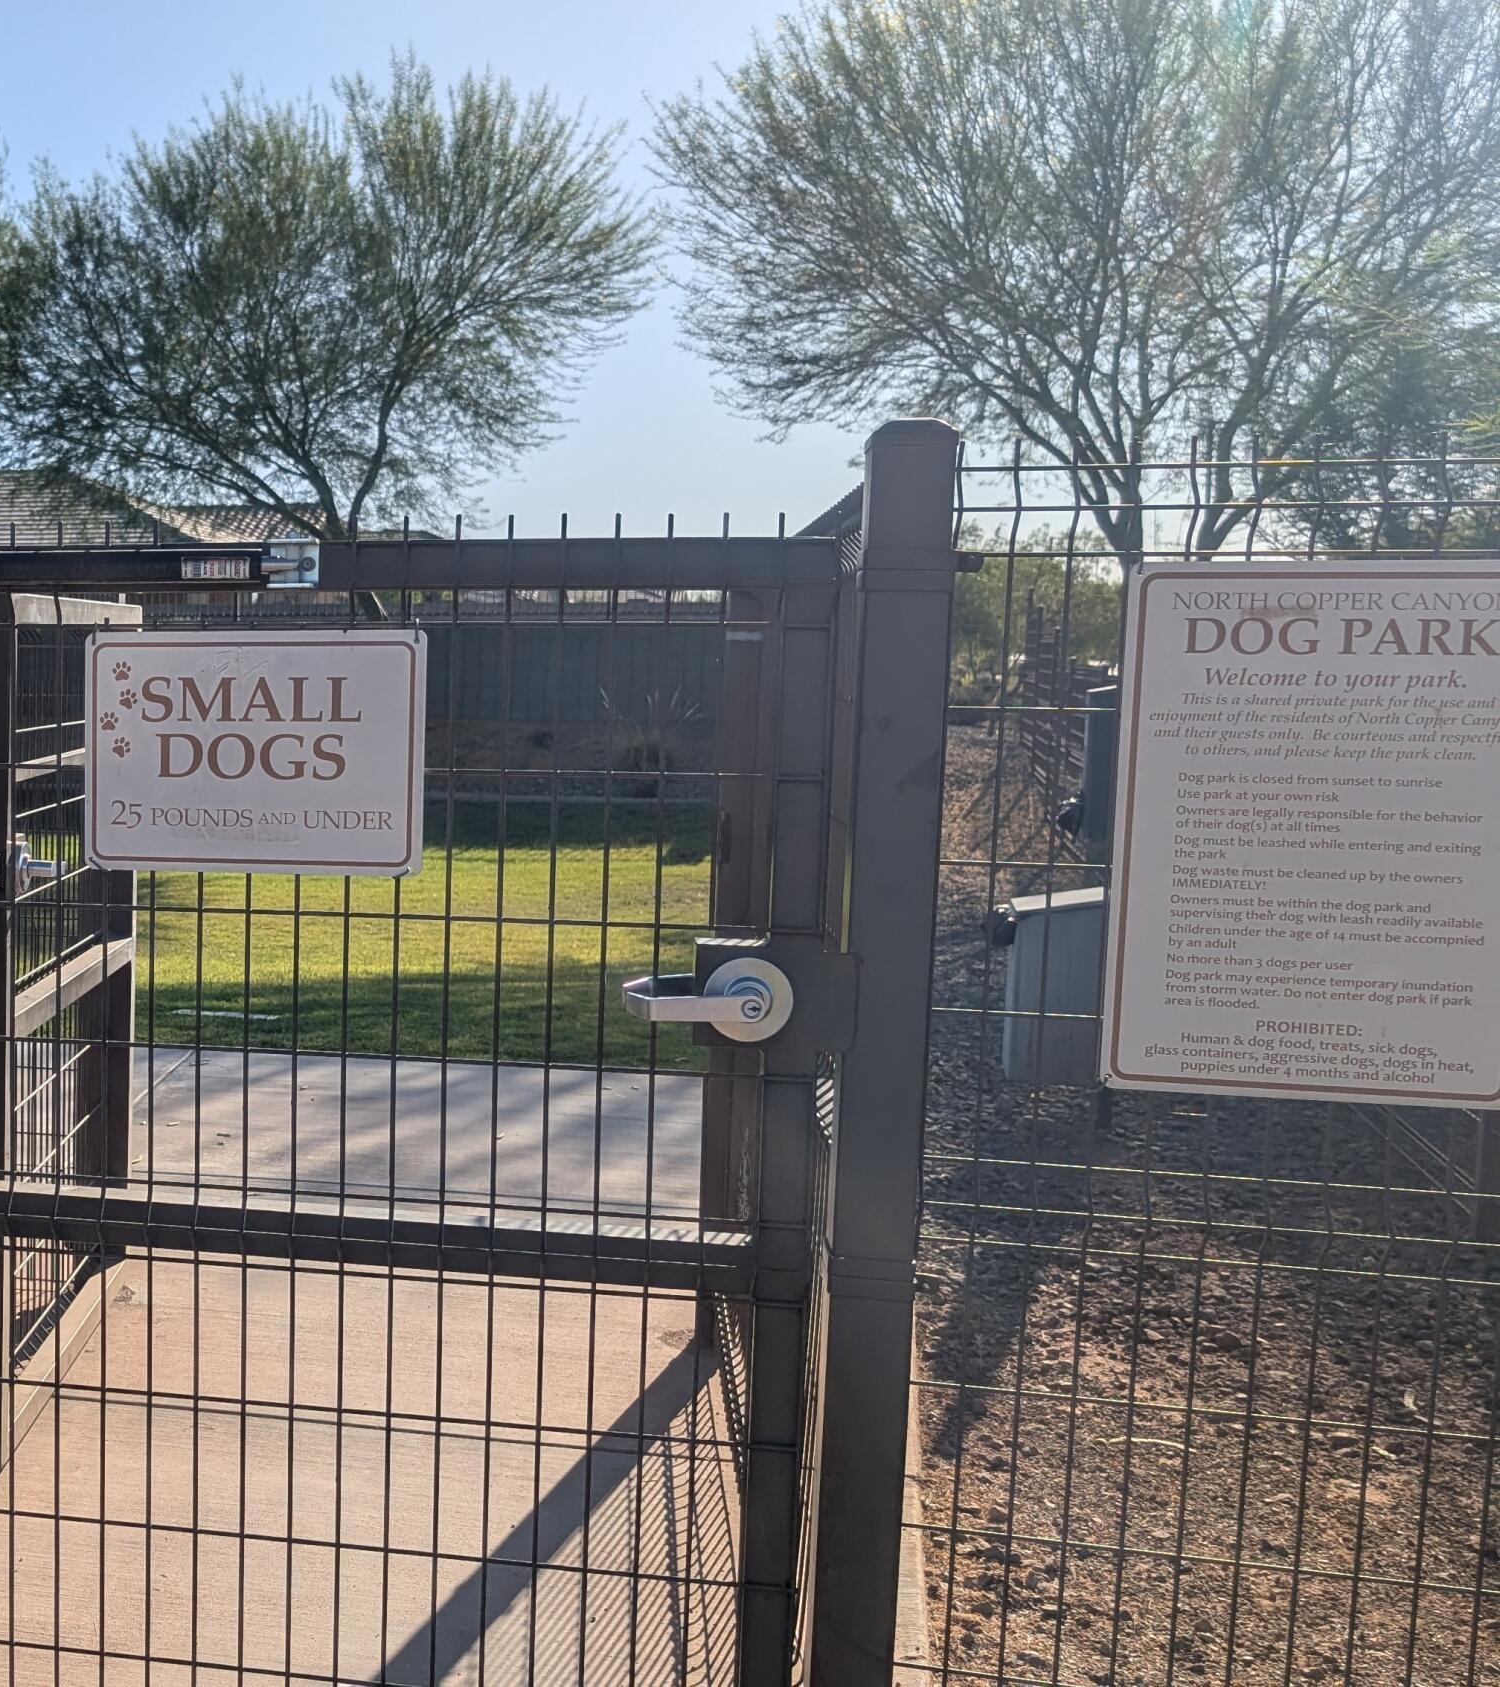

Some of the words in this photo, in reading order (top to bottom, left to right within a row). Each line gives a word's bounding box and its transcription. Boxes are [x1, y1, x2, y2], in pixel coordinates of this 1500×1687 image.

[1172, 591, 1268, 610] NORTH
[1276, 592, 1382, 611] COPPER
[1183, 617, 1320, 656] DOG
[1337, 618, 1500, 656] PARK
[1204, 667, 1307, 687] Welcome
[1313, 669, 1337, 687] to
[1344, 672, 1399, 693] your
[1404, 670, 1467, 693] park.
[141, 676, 362, 723] SMALL
[1181, 693, 1212, 705] This
[1216, 694, 1227, 705] is
[1231, 696, 1240, 705] a
[1244, 694, 1291, 706] shared
[1294, 695, 1346, 709] private
[1349, 696, 1384, 710] park
[1385, 696, 1409, 711] for
[1413, 696, 1436, 708] the
[1439, 699, 1463, 709] use
[1467, 697, 1496, 709] and
[1149, 710, 1224, 724] enjoyment
[1226, 710, 1243, 725] of
[1245, 711, 1268, 723] the
[1270, 711, 1334, 724] residents
[1338, 712, 1356, 727] of
[1356, 712, 1400, 725] North
[1404, 713, 1457, 728] Copper
[1153, 727, 1181, 738] and
[1184, 727, 1217, 738] their
[1219, 729, 1265, 742] guests
[1268, 728, 1304, 742] only.
[1313, 729, 1330, 741] Be
[1334, 731, 1404, 742] courteous
[1408, 731, 1436, 742] and
[155, 733, 346, 781] DOGS
[1184, 744, 1199, 755] to
[1203, 744, 1251, 757] others,
[1254, 745, 1282, 757] and
[1284, 746, 1330, 760] please
[1333, 746, 1366, 761] keep
[1370, 747, 1394, 759] the
[1395, 748, 1429, 762] park
[1433, 748, 1477, 760] clean.
[1178, 772, 1204, 785] Dog
[1207, 773, 1236, 785] park
[1239, 773, 1249, 784] is
[1252, 774, 1293, 785] closed
[1297, 774, 1328, 785] from
[1331, 776, 1374, 787] sunset
[1378, 777, 1392, 787] to
[1395, 777, 1443, 788] sunrise
[110, 800, 142, 829] 25
[150, 807, 253, 828] POUNDS
[258, 812, 296, 825] AND
[303, 810, 394, 831] UNDER
[1176, 805, 1225, 817] Owners
[1228, 808, 1249, 817] are
[1252, 807, 1294, 820] legally
[1297, 809, 1373, 821] responsible
[1376, 810, 1396, 820] for
[1399, 811, 1421, 822] the
[1424, 811, 1483, 823] behavior
[1176, 818, 1189, 829] of
[1193, 818, 1223, 830] their
[1226, 819, 1267, 833] dog(s)
[1270, 822, 1283, 831] at
[1286, 821, 1301, 832] all
[1304, 821, 1341, 833] times
[1174, 835, 1199, 848] Dog
[1203, 837, 1235, 847] must
[1238, 836, 1253, 847] be
[1257, 837, 1306, 849] leashed
[1310, 839, 1345, 850] while
[1348, 840, 1404, 854] entering
[1407, 842, 1432, 853] and
[1435, 842, 1481, 856] exiting
[1172, 865, 1197, 877] Dog
[1201, 867, 1239, 877] waste
[1242, 868, 1274, 878] must
[1277, 868, 1293, 879] be
[1296, 868, 1346, 880] cleaned
[1350, 872, 1366, 883] up
[1369, 871, 1385, 884] by
[1389, 871, 1410, 882] the
[1413, 874, 1464, 884] owners
[1172, 878, 1266, 891] IMMEDIATELY!
[1170, 894, 1219, 906] Owners
[1222, 897, 1254, 907] must
[1258, 897, 1273, 908] be
[1277, 898, 1317, 910] within
[1321, 900, 1343, 911] the
[1346, 901, 1370, 914] dog
[1374, 902, 1403, 914] park
[1406, 903, 1431, 913] and
[1170, 909, 1242, 922] supervising
[1245, 910, 1276, 921] their
[1279, 911, 1304, 925] dog
[1307, 912, 1336, 923] with
[1340, 913, 1373, 925] leash
[1376, 915, 1421, 929] readily
[1424, 917, 1483, 929] available
[1168, 924, 1221, 936] Children
[1224, 927, 1262, 937] under
[1265, 927, 1286, 938] the
[1289, 929, 1313, 941] age
[1315, 929, 1330, 941] of
[1333, 932, 1345, 942] 14
[1349, 932, 1382, 942] must
[1385, 932, 1400, 943] be
[1165, 969, 1191, 982] Dog
[1194, 971, 1222, 982] park
[1225, 973, 1252, 984] may
[1255, 974, 1326, 986] experience
[1330, 977, 1398, 991] temporary
[1402, 980, 1473, 993] inundation
[1165, 982, 1196, 993] from
[1199, 985, 1237, 995] storm
[1240, 987, 1281, 997] water.
[1284, 988, 1301, 999] Do
[1304, 990, 1328, 1000] not
[1330, 991, 1365, 1001] enter
[1368, 992, 1394, 1006] dog
[1396, 994, 1427, 1006] park
[1429, 993, 1440, 1005] if
[1442, 995, 1472, 1008] park
[1255, 1020, 1363, 1037] PROHIBITED:
[1181, 1032, 1230, 1045] Human
[1233, 1035, 1244, 1046] &
[1247, 1036, 1275, 1050] dog
[1279, 1037, 1315, 1051] food,
[1319, 1040, 1365, 1054] treats,
[1368, 1042, 1395, 1054] sick
[1399, 1043, 1437, 1059] dogs,
[1144, 1044, 1179, 1058] glass
[1182, 1047, 1259, 1062] containers,
[1262, 1052, 1337, 1065] aggressive
[1341, 1055, 1379, 1069] dogs,
[1382, 1057, 1417, 1072] dogs
[1421, 1058, 1434, 1070] in
[1438, 1060, 1474, 1074] heat,
[1180, 1061, 1235, 1074] puppies
[1239, 1063, 1280, 1075] under
[1283, 1067, 1291, 1078] 4
[1295, 1068, 1349, 1079] months
[1353, 1070, 1379, 1081] and
[1383, 1071, 1435, 1084] alcohol
